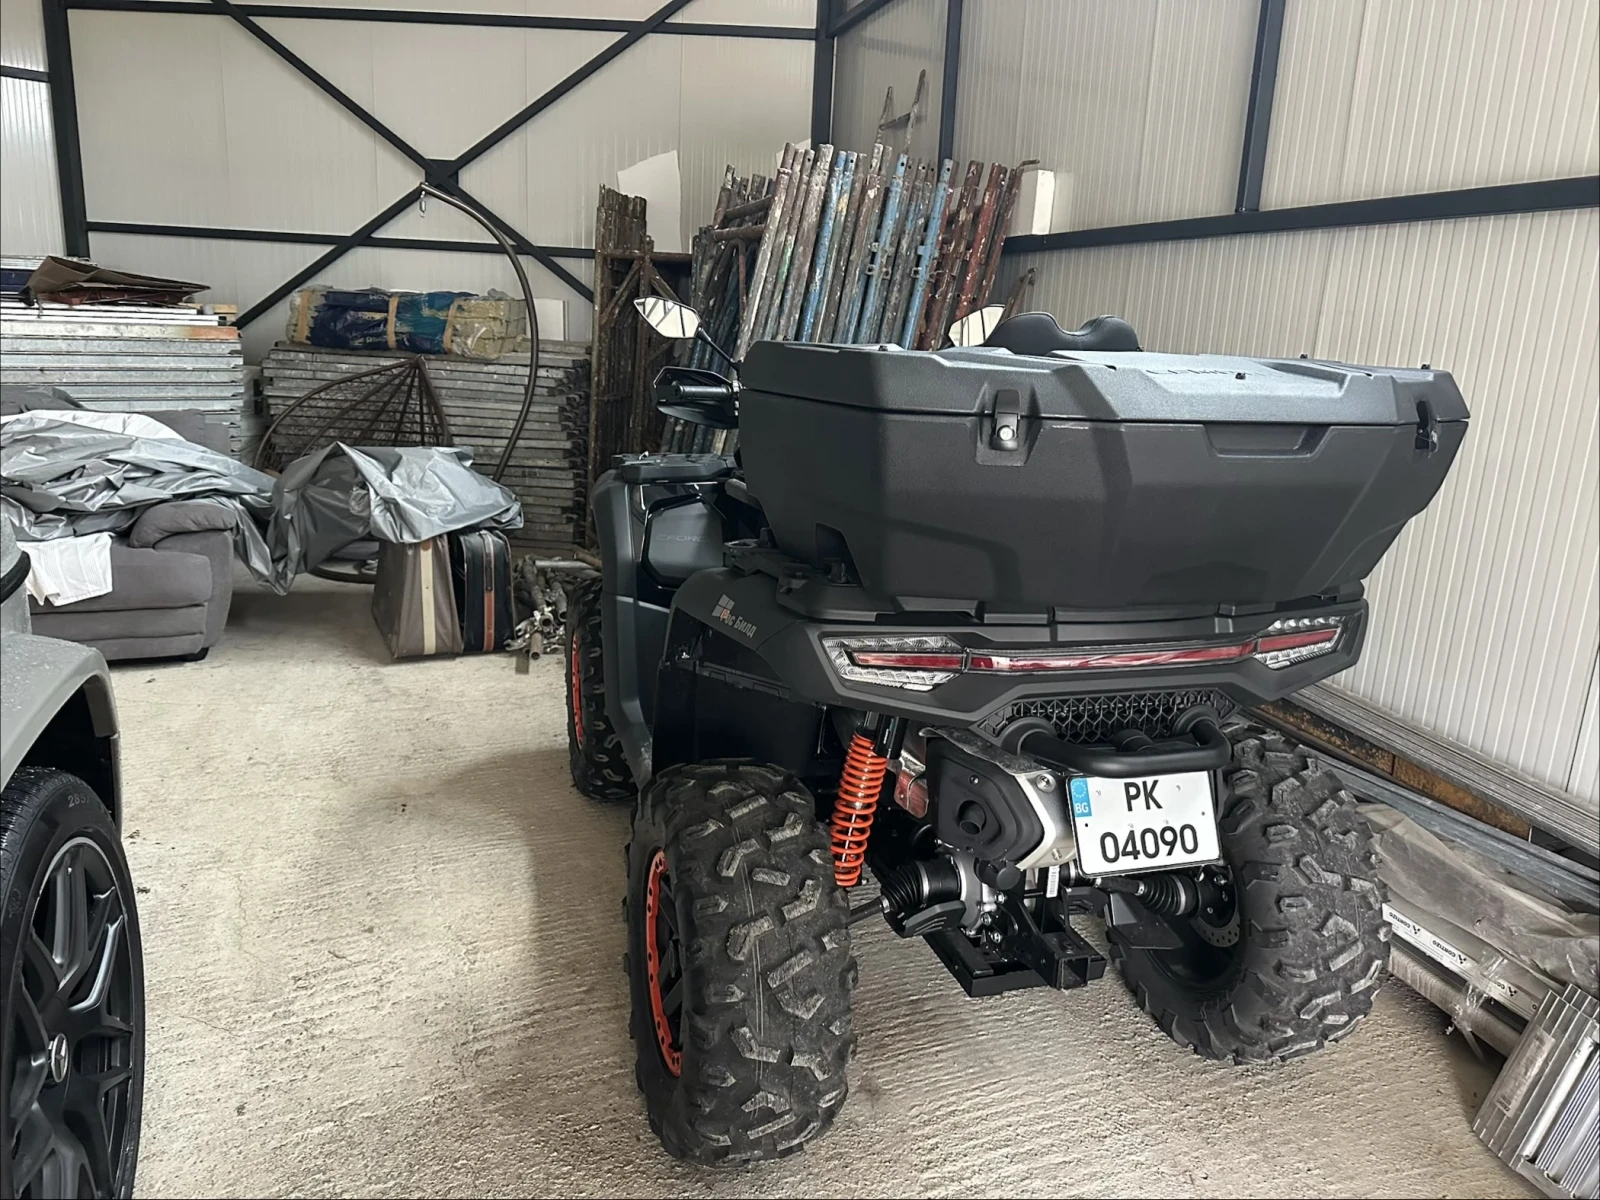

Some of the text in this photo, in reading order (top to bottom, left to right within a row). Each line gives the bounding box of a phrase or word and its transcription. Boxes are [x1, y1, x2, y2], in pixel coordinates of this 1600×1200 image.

[1074, 802, 1089, 813] BG
[1124, 779, 1163, 812] PK
[1100, 823, 1199, 863] 04090
[1432, 940, 1456, 958] CORTIZO
